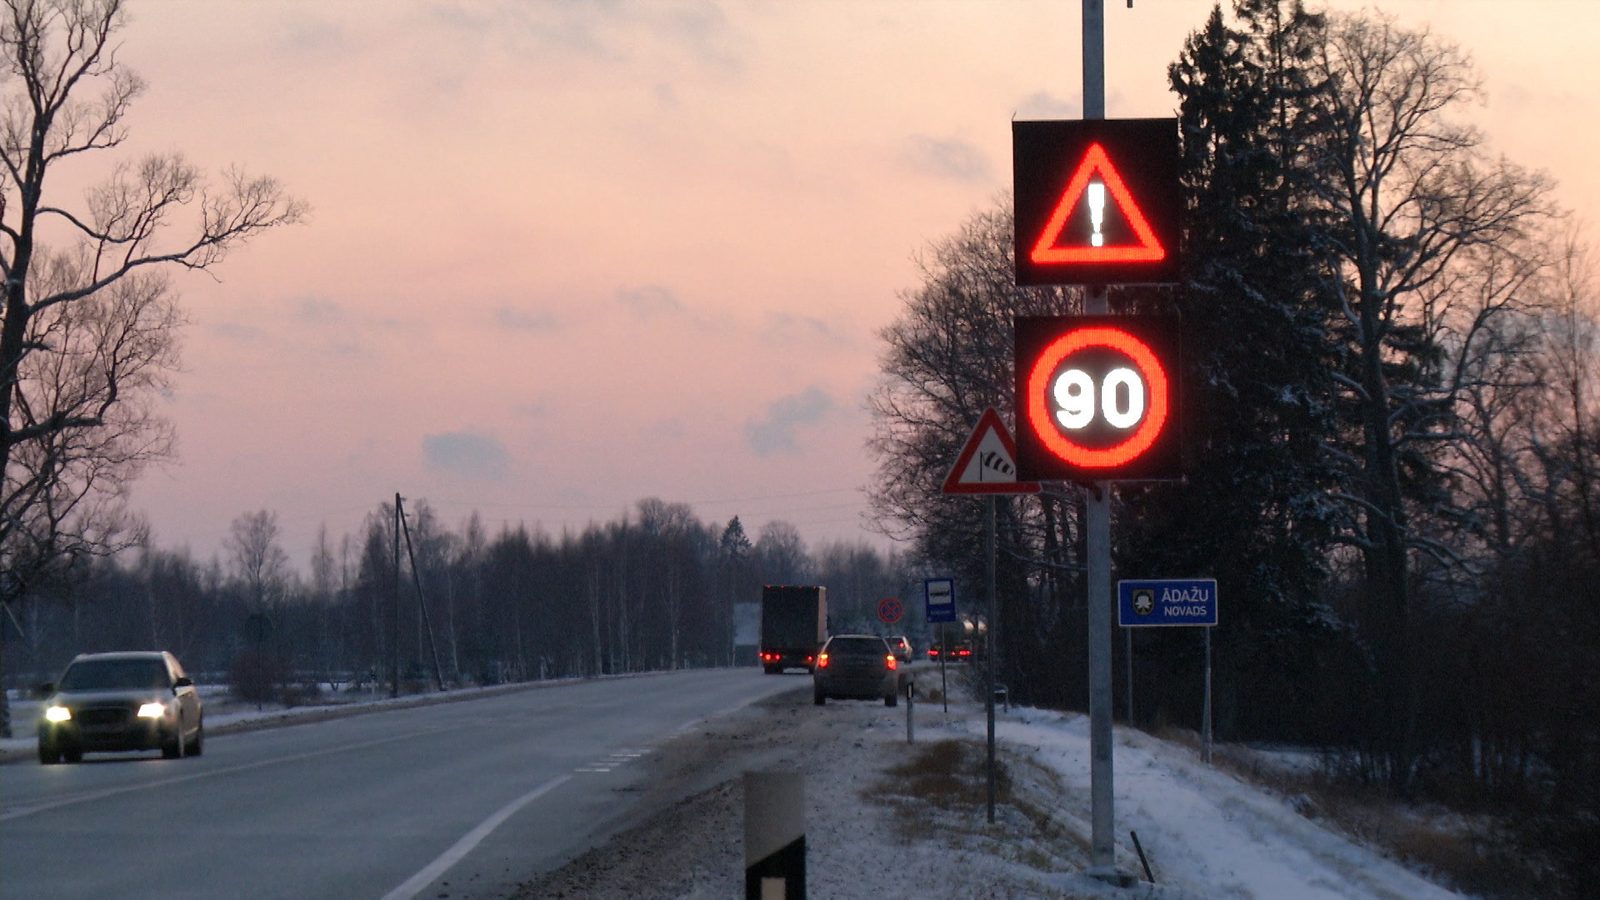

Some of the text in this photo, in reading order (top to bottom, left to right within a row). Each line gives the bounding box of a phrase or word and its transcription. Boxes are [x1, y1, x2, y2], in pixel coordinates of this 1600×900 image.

[1053, 367, 1144, 429] 90
[1161, 586, 1209, 602] ĀDAŽU
[1164, 606, 1207, 616] NOVADS
